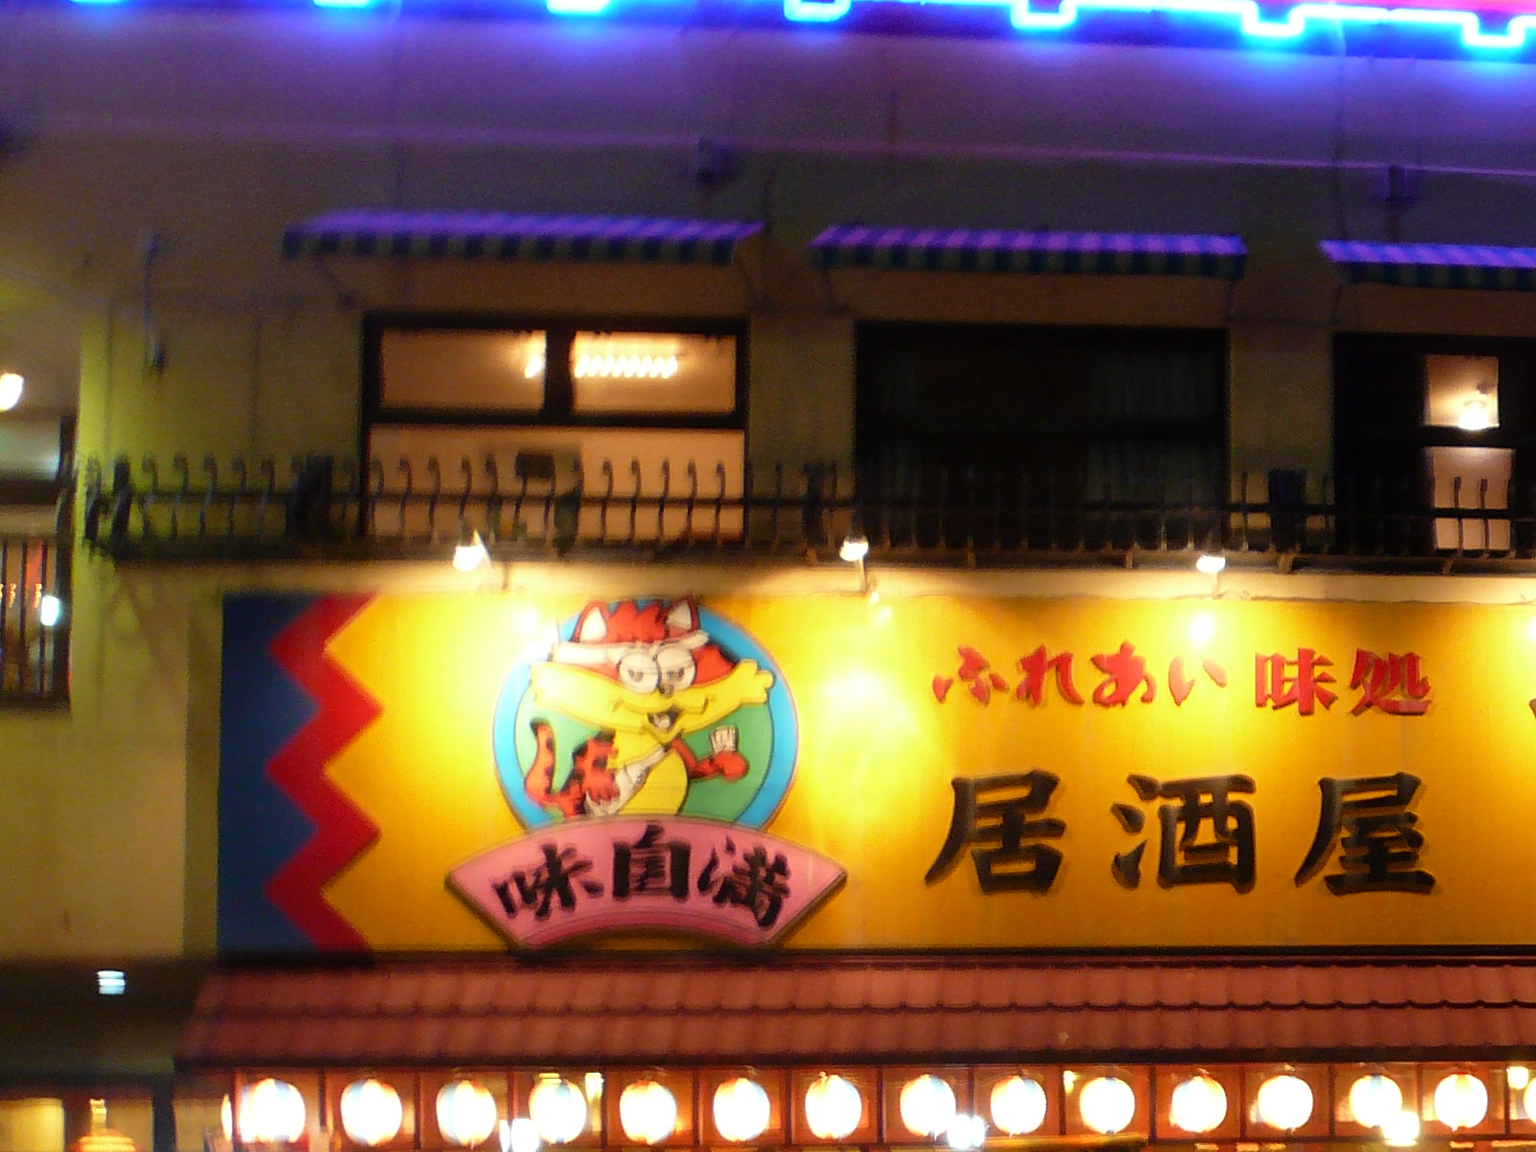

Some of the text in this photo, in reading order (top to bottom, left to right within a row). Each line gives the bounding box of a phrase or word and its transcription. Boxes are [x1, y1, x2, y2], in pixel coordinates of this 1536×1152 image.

[931, 641, 1433, 718] ふれあい味処
[924, 768, 1438, 898] 居酒屋
